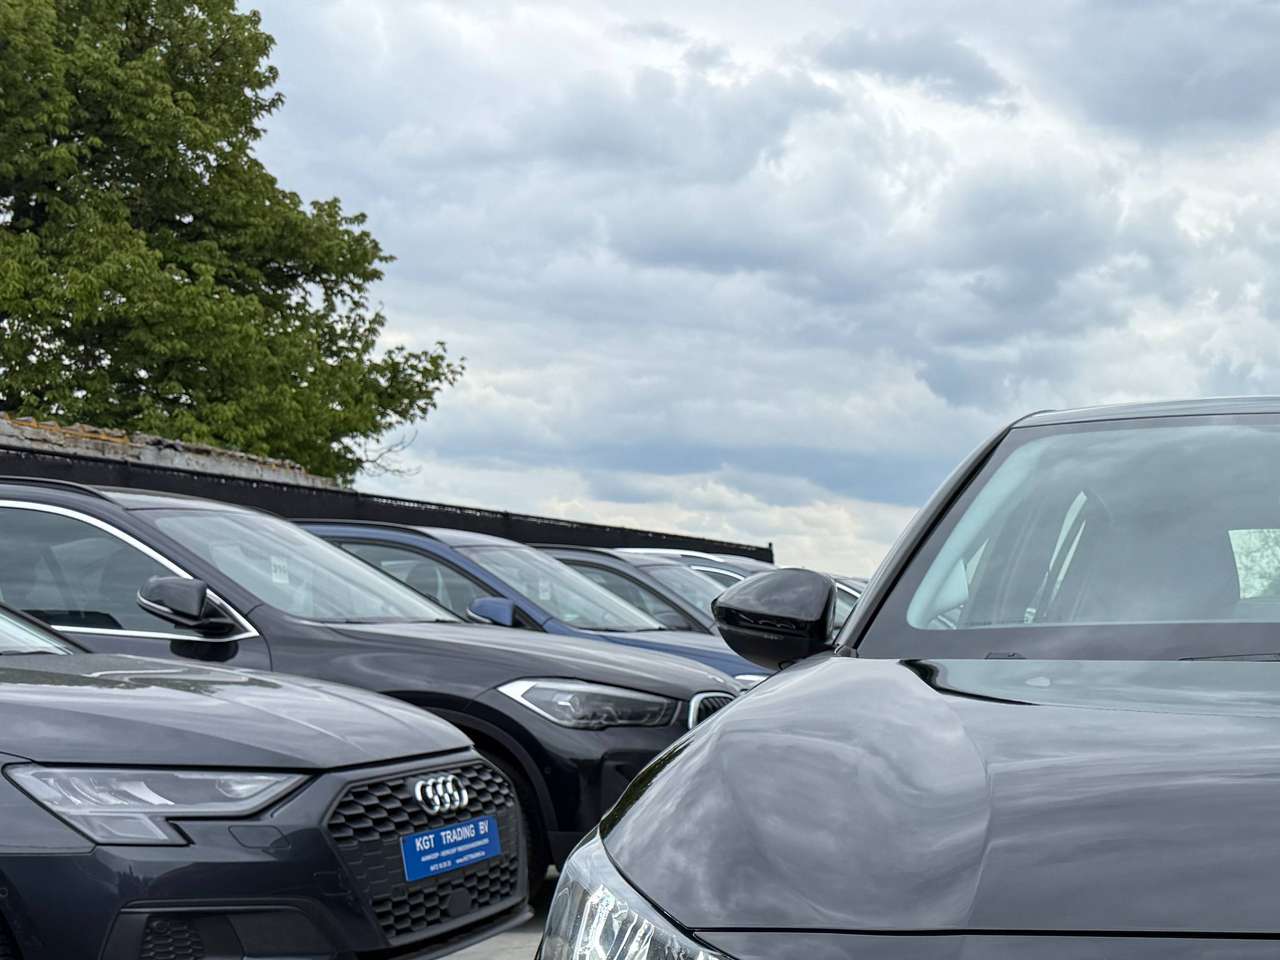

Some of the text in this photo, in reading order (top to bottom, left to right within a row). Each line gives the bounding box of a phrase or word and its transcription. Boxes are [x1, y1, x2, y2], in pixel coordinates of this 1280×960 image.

[415, 834, 435, 851] KGT
[440, 824, 475, 845] TRADING
[478, 820, 489, 835] BV
